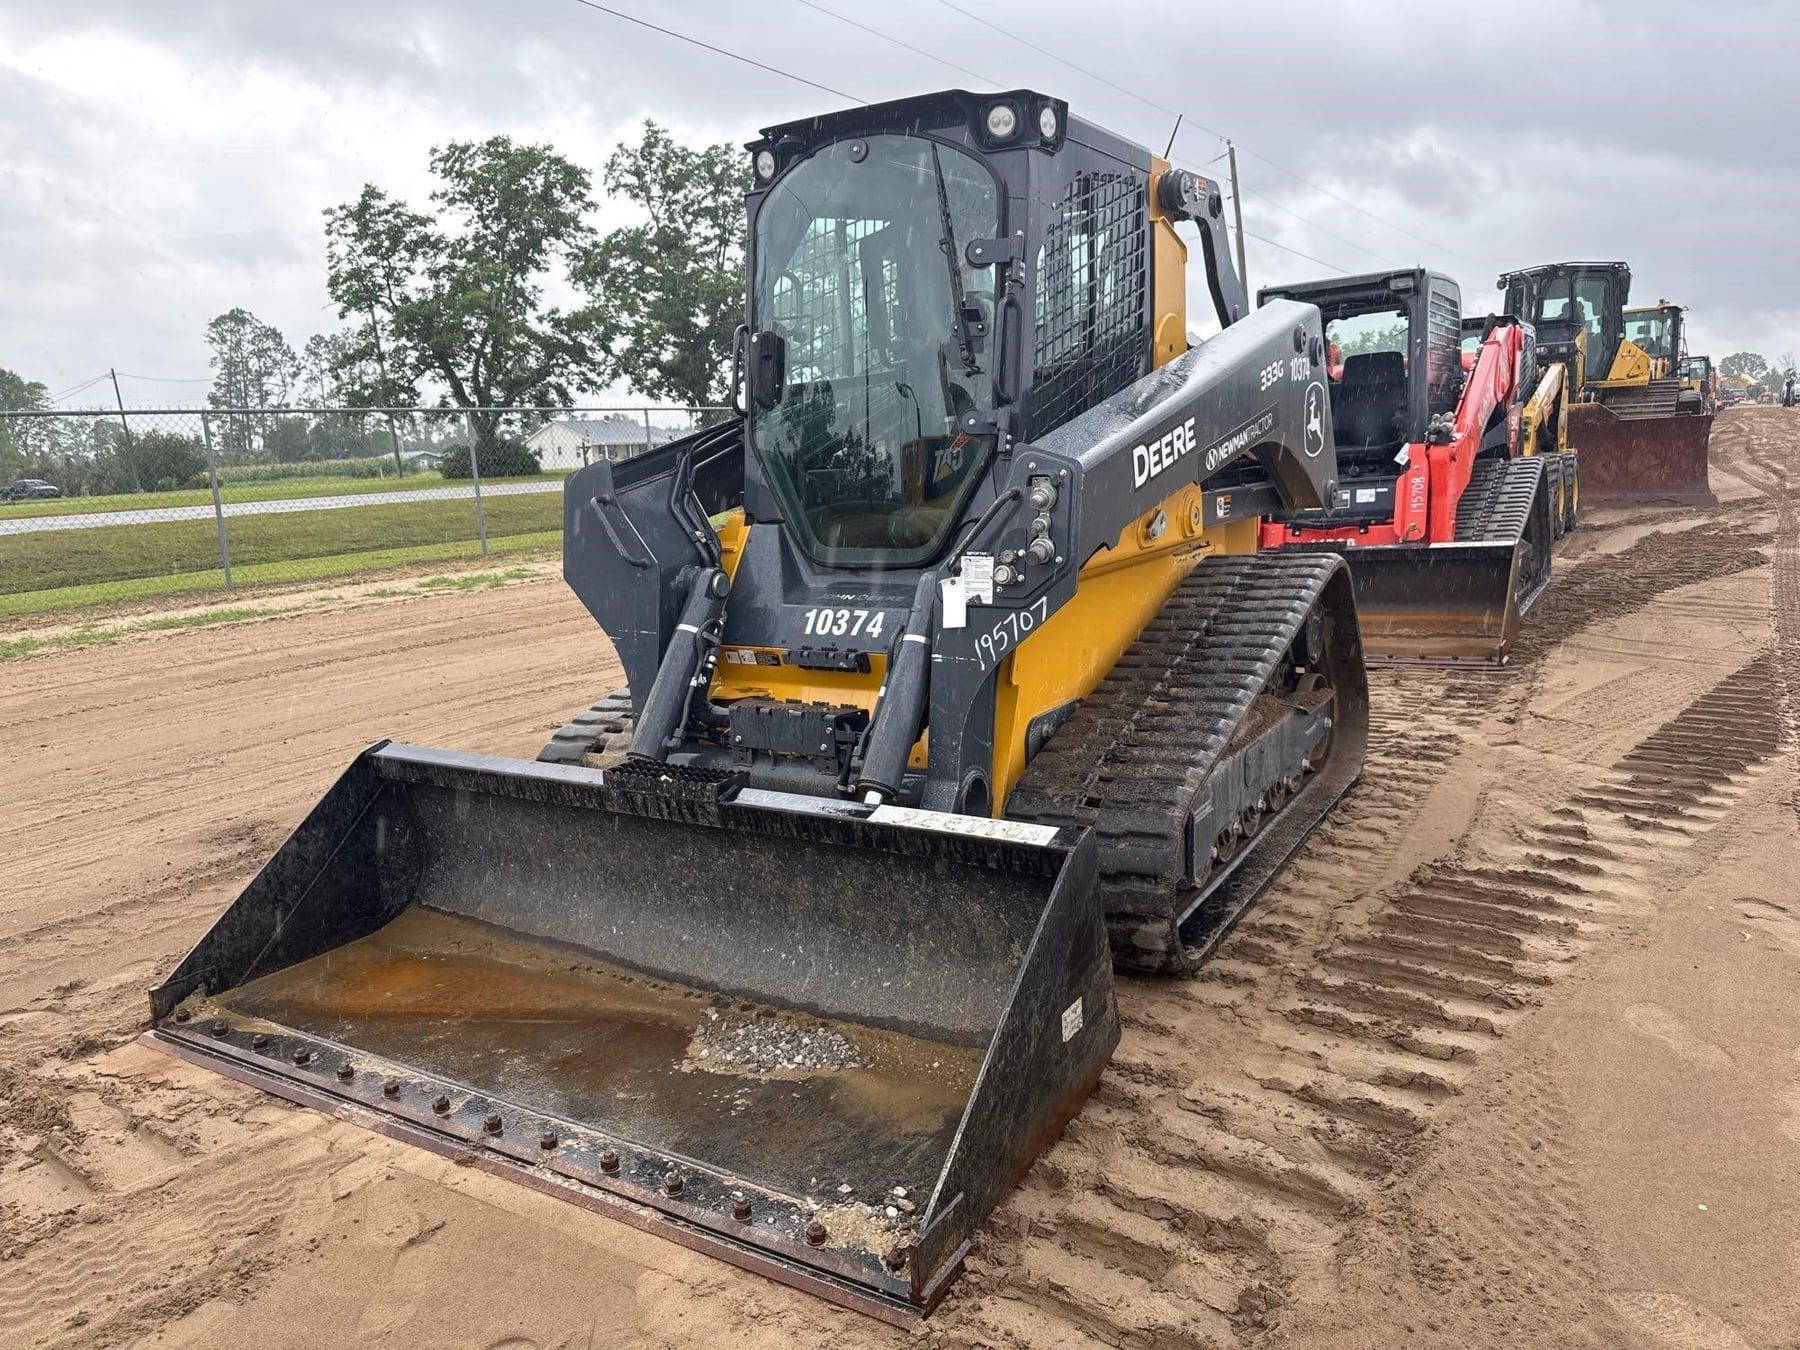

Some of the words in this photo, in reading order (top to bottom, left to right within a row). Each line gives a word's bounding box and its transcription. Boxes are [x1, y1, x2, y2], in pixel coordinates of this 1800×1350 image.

[1260, 359, 1284, 392] 333G
[1290, 357, 1310, 381] 10374
[1132, 416, 1197, 489] DEERE
[1410, 475, 1426, 513] 195708
[804, 609, 884, 637] 10374
[974, 595, 1048, 671] 195707
